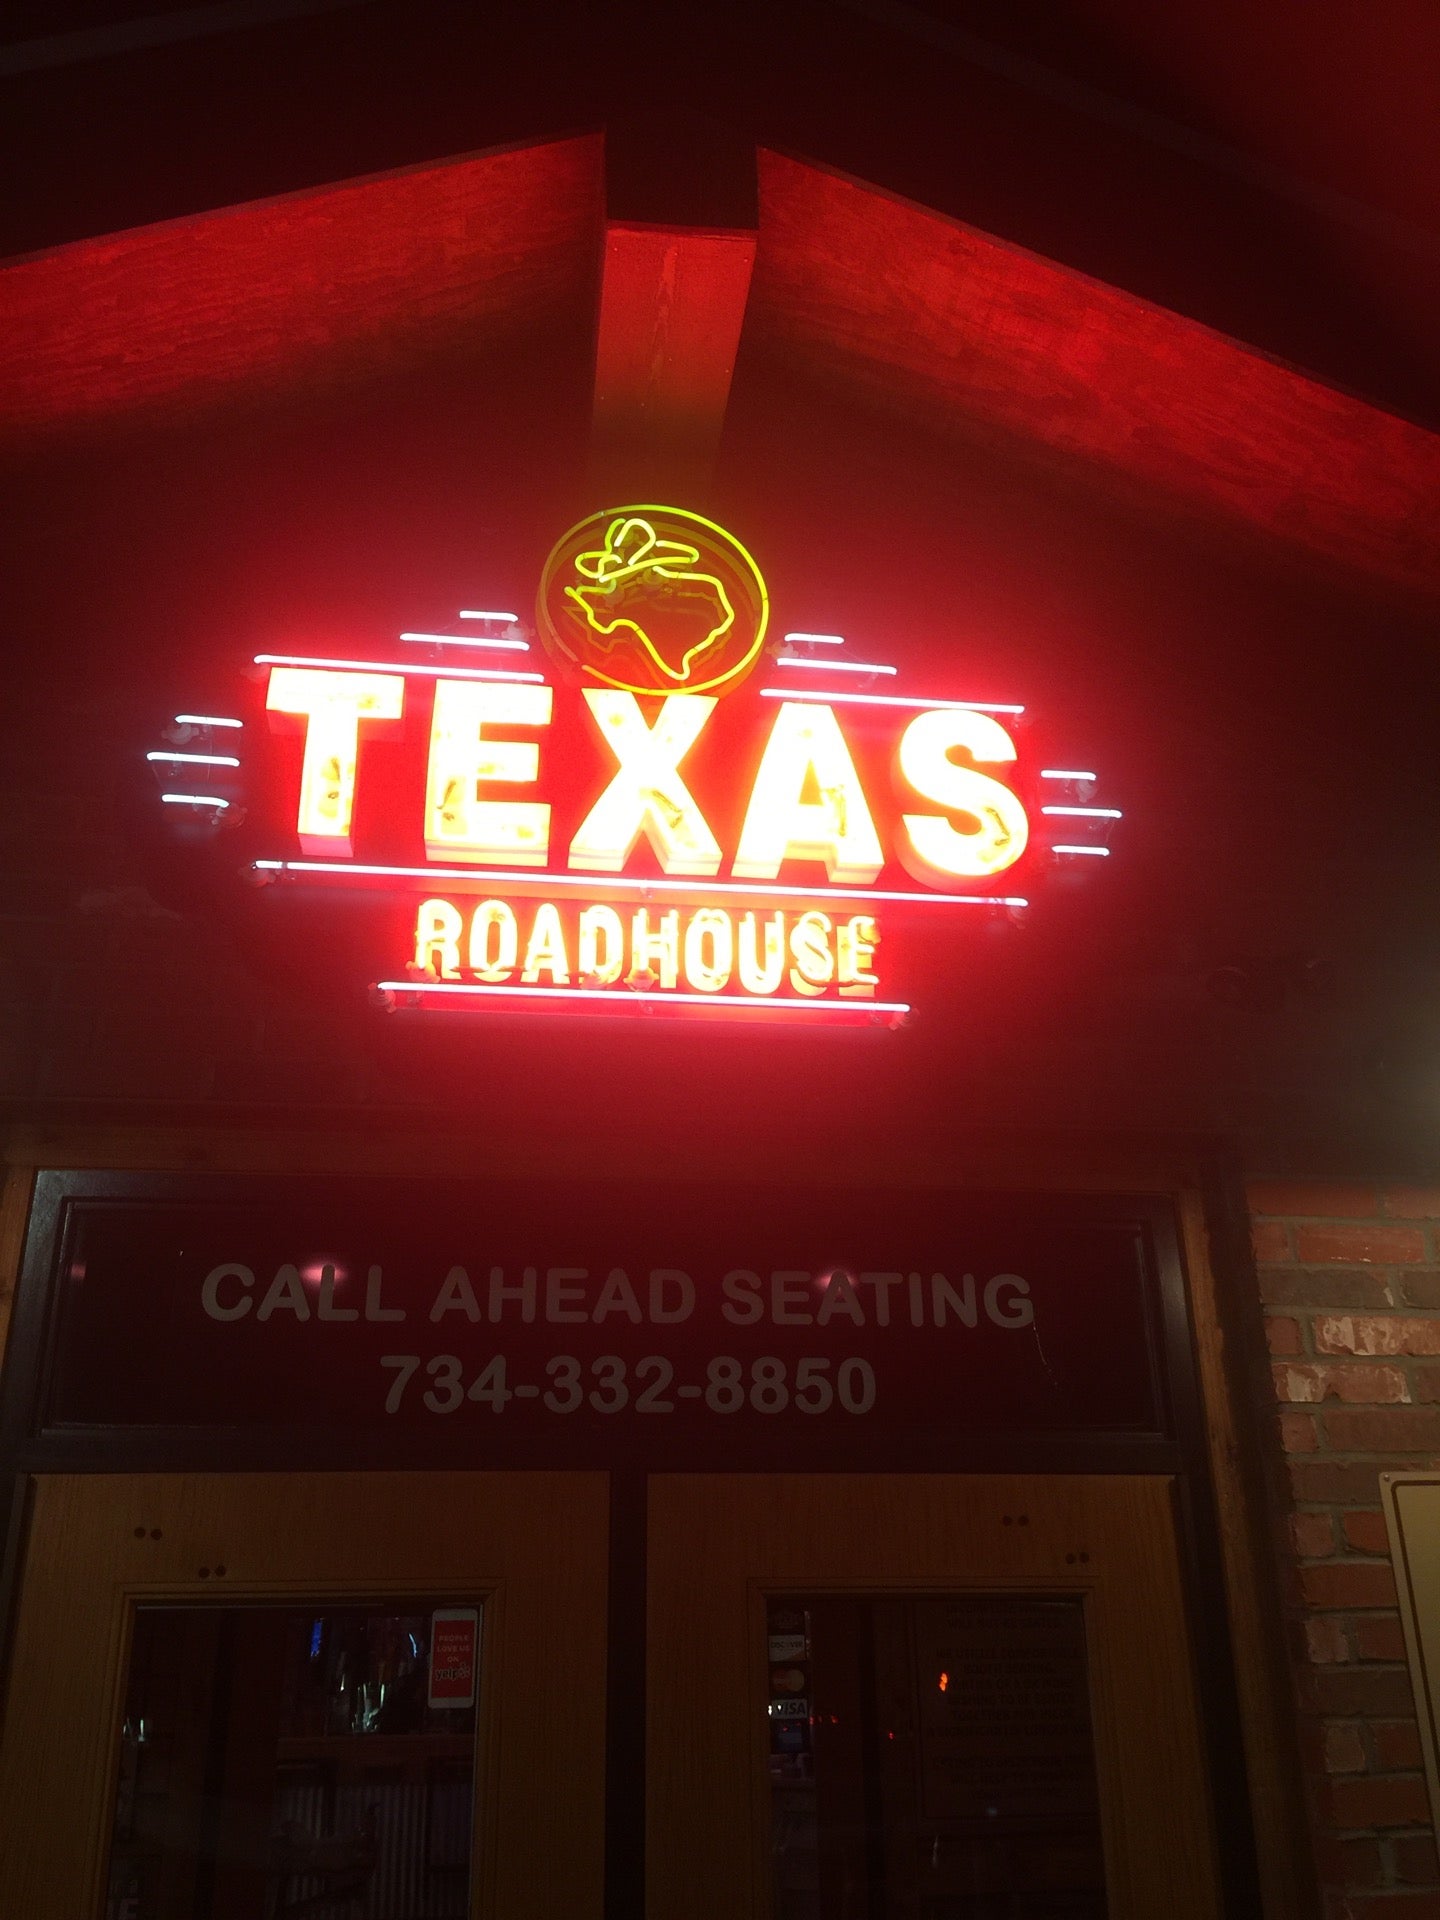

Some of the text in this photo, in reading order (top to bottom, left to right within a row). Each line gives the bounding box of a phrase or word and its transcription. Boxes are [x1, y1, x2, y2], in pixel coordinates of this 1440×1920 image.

[265, 667, 1029, 886] TEXAS
[414, 899, 880, 997] ROADHOUSE
[202, 1263, 1036, 1329] CALL AHEAD SEATING
[380, 1355, 877, 1414] 734-332-8850
[776, 1702, 806, 1715] VISA
